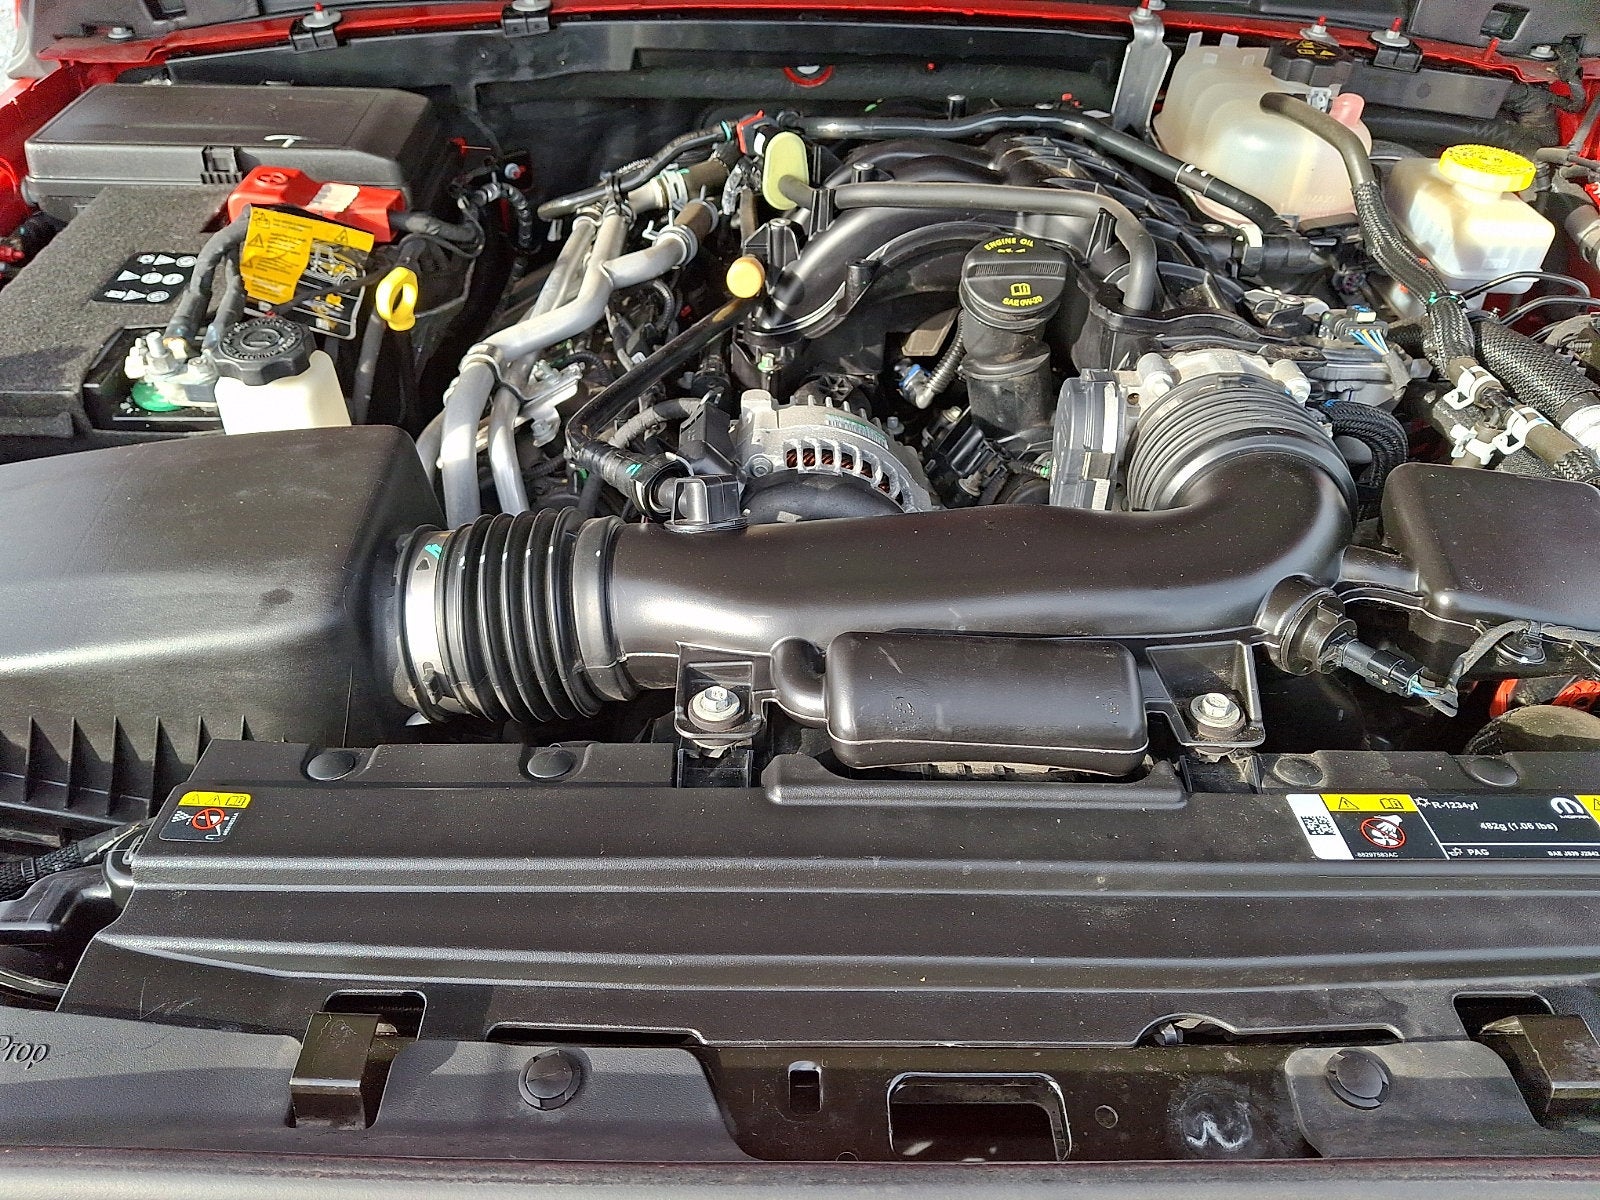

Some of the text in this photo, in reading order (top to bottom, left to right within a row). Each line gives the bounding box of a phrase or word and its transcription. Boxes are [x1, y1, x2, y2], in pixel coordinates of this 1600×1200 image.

[984, 238, 1034, 251] ENGINE OIL
[1002, 297, 1020, 306] SAE
[1431, 801, 1479, 811] R-1234yf
[1466, 848, 1490, 856] PAG
